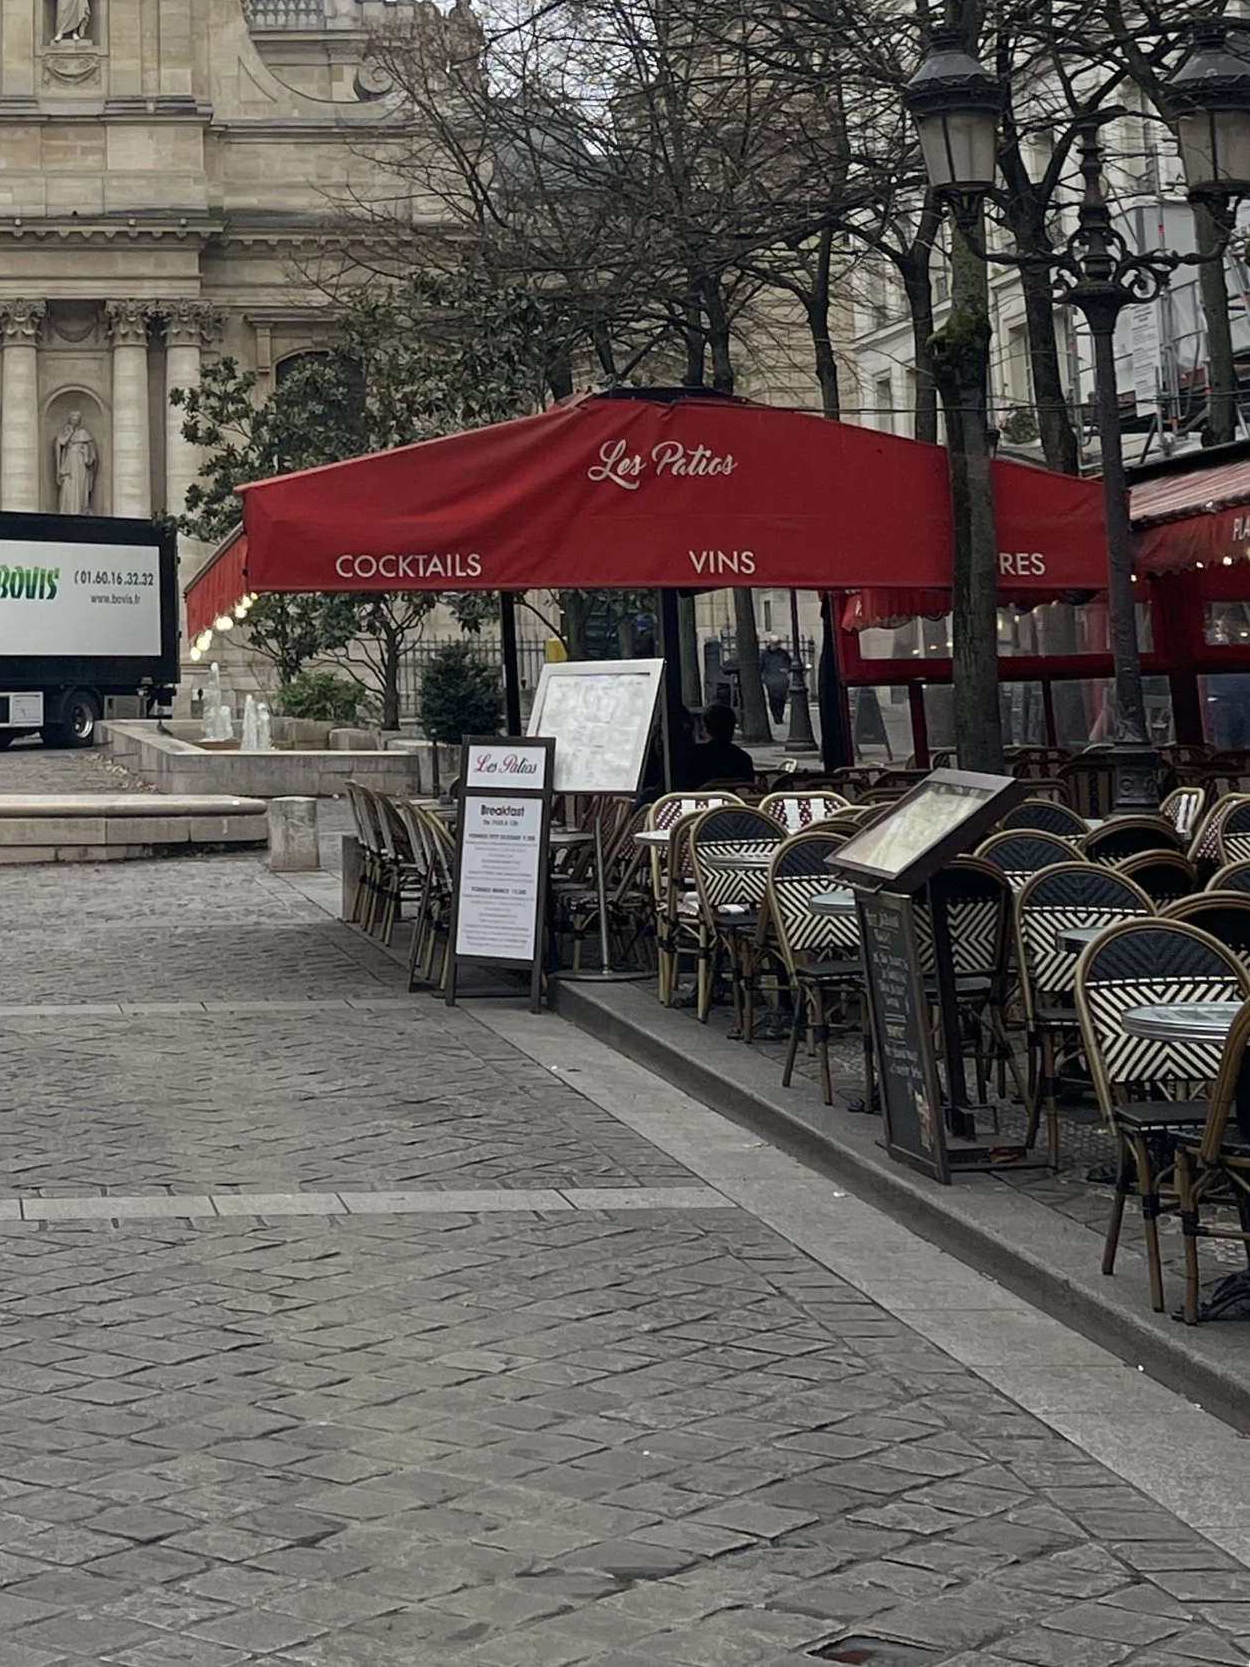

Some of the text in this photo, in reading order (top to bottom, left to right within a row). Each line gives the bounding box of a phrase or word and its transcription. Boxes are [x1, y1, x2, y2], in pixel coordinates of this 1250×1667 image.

[587, 439, 738, 490] Les Patios
[335, 553, 482, 578] COCKTAILS
[688, 550, 756, 575] VINS
[91, 594, 141, 605] www.bovis.fr
[473, 753, 538, 775] Les Patios
[481, 804, 526, 818] Breakfast
